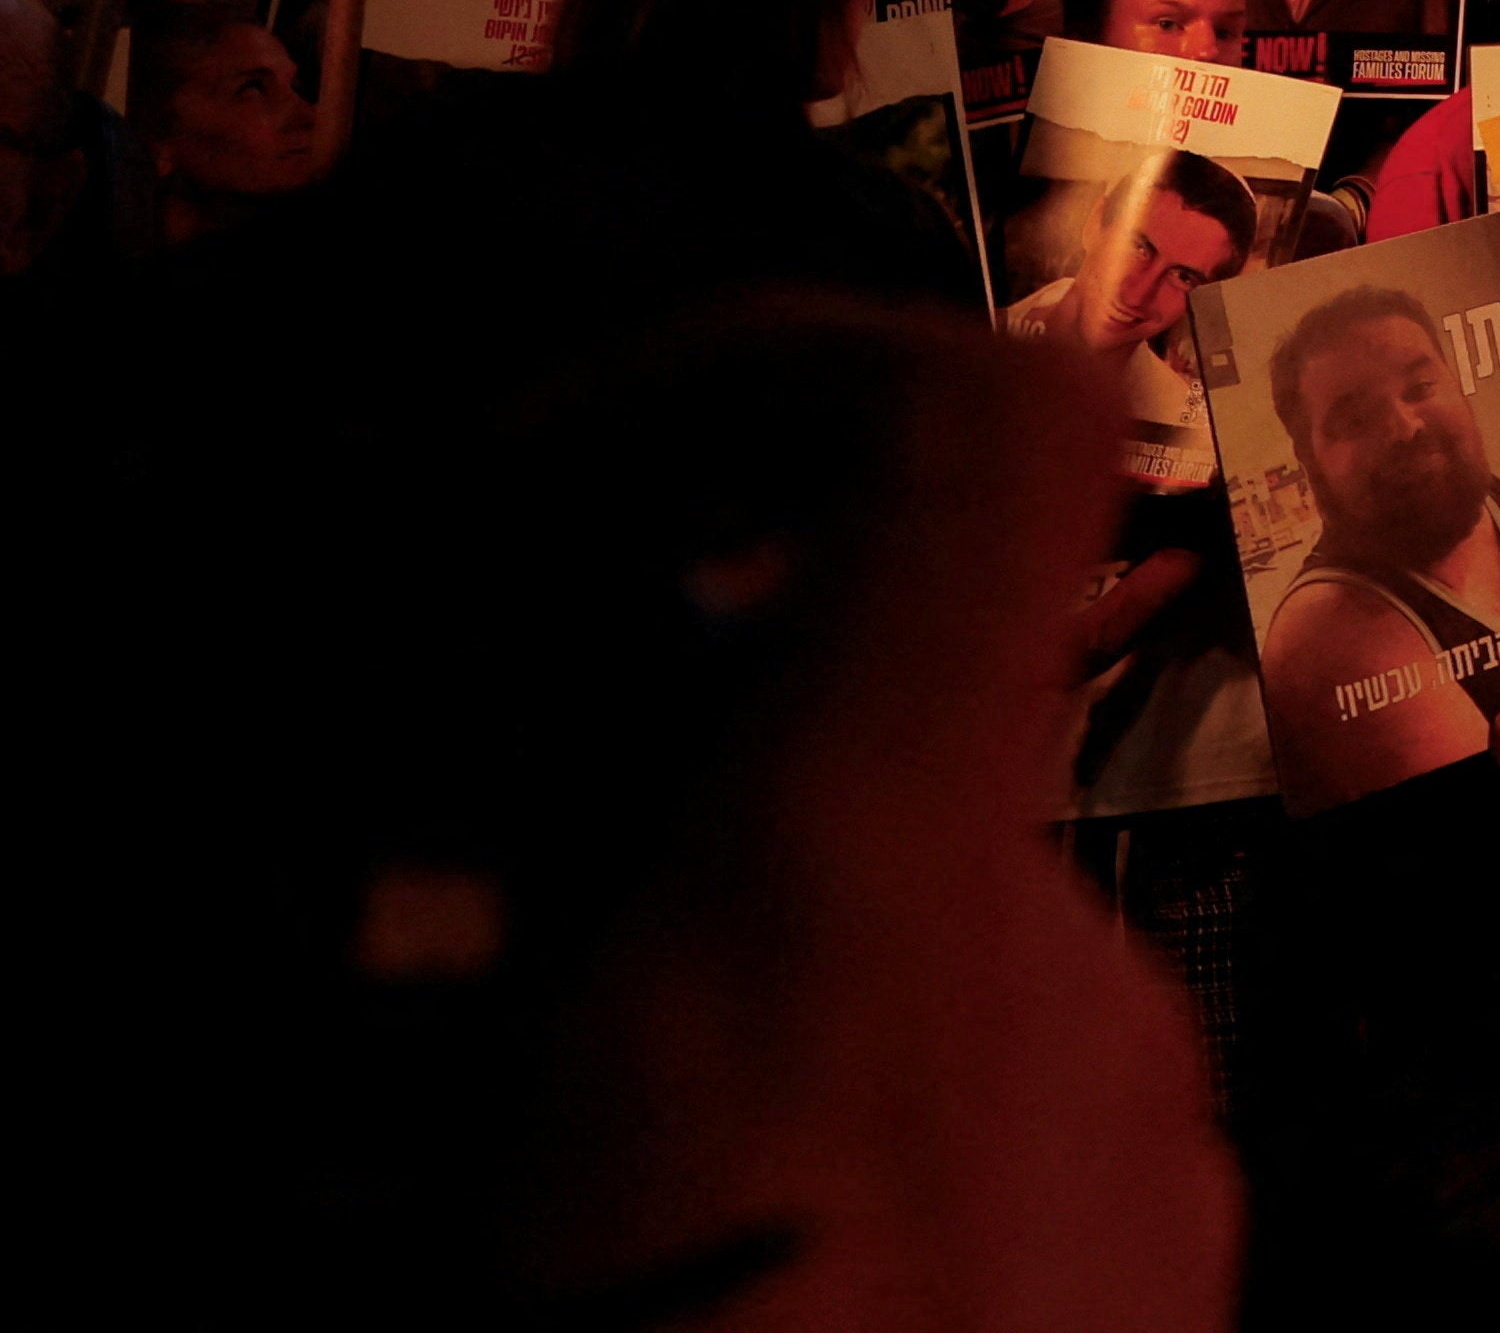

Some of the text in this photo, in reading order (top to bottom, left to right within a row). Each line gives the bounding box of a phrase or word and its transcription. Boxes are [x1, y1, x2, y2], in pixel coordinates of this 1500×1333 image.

[485, 19, 526, 41] BIPIN
[1353, 62, 1444, 80] FAMILIES FORUM
[1181, 95, 1238, 125] GOLDIN
